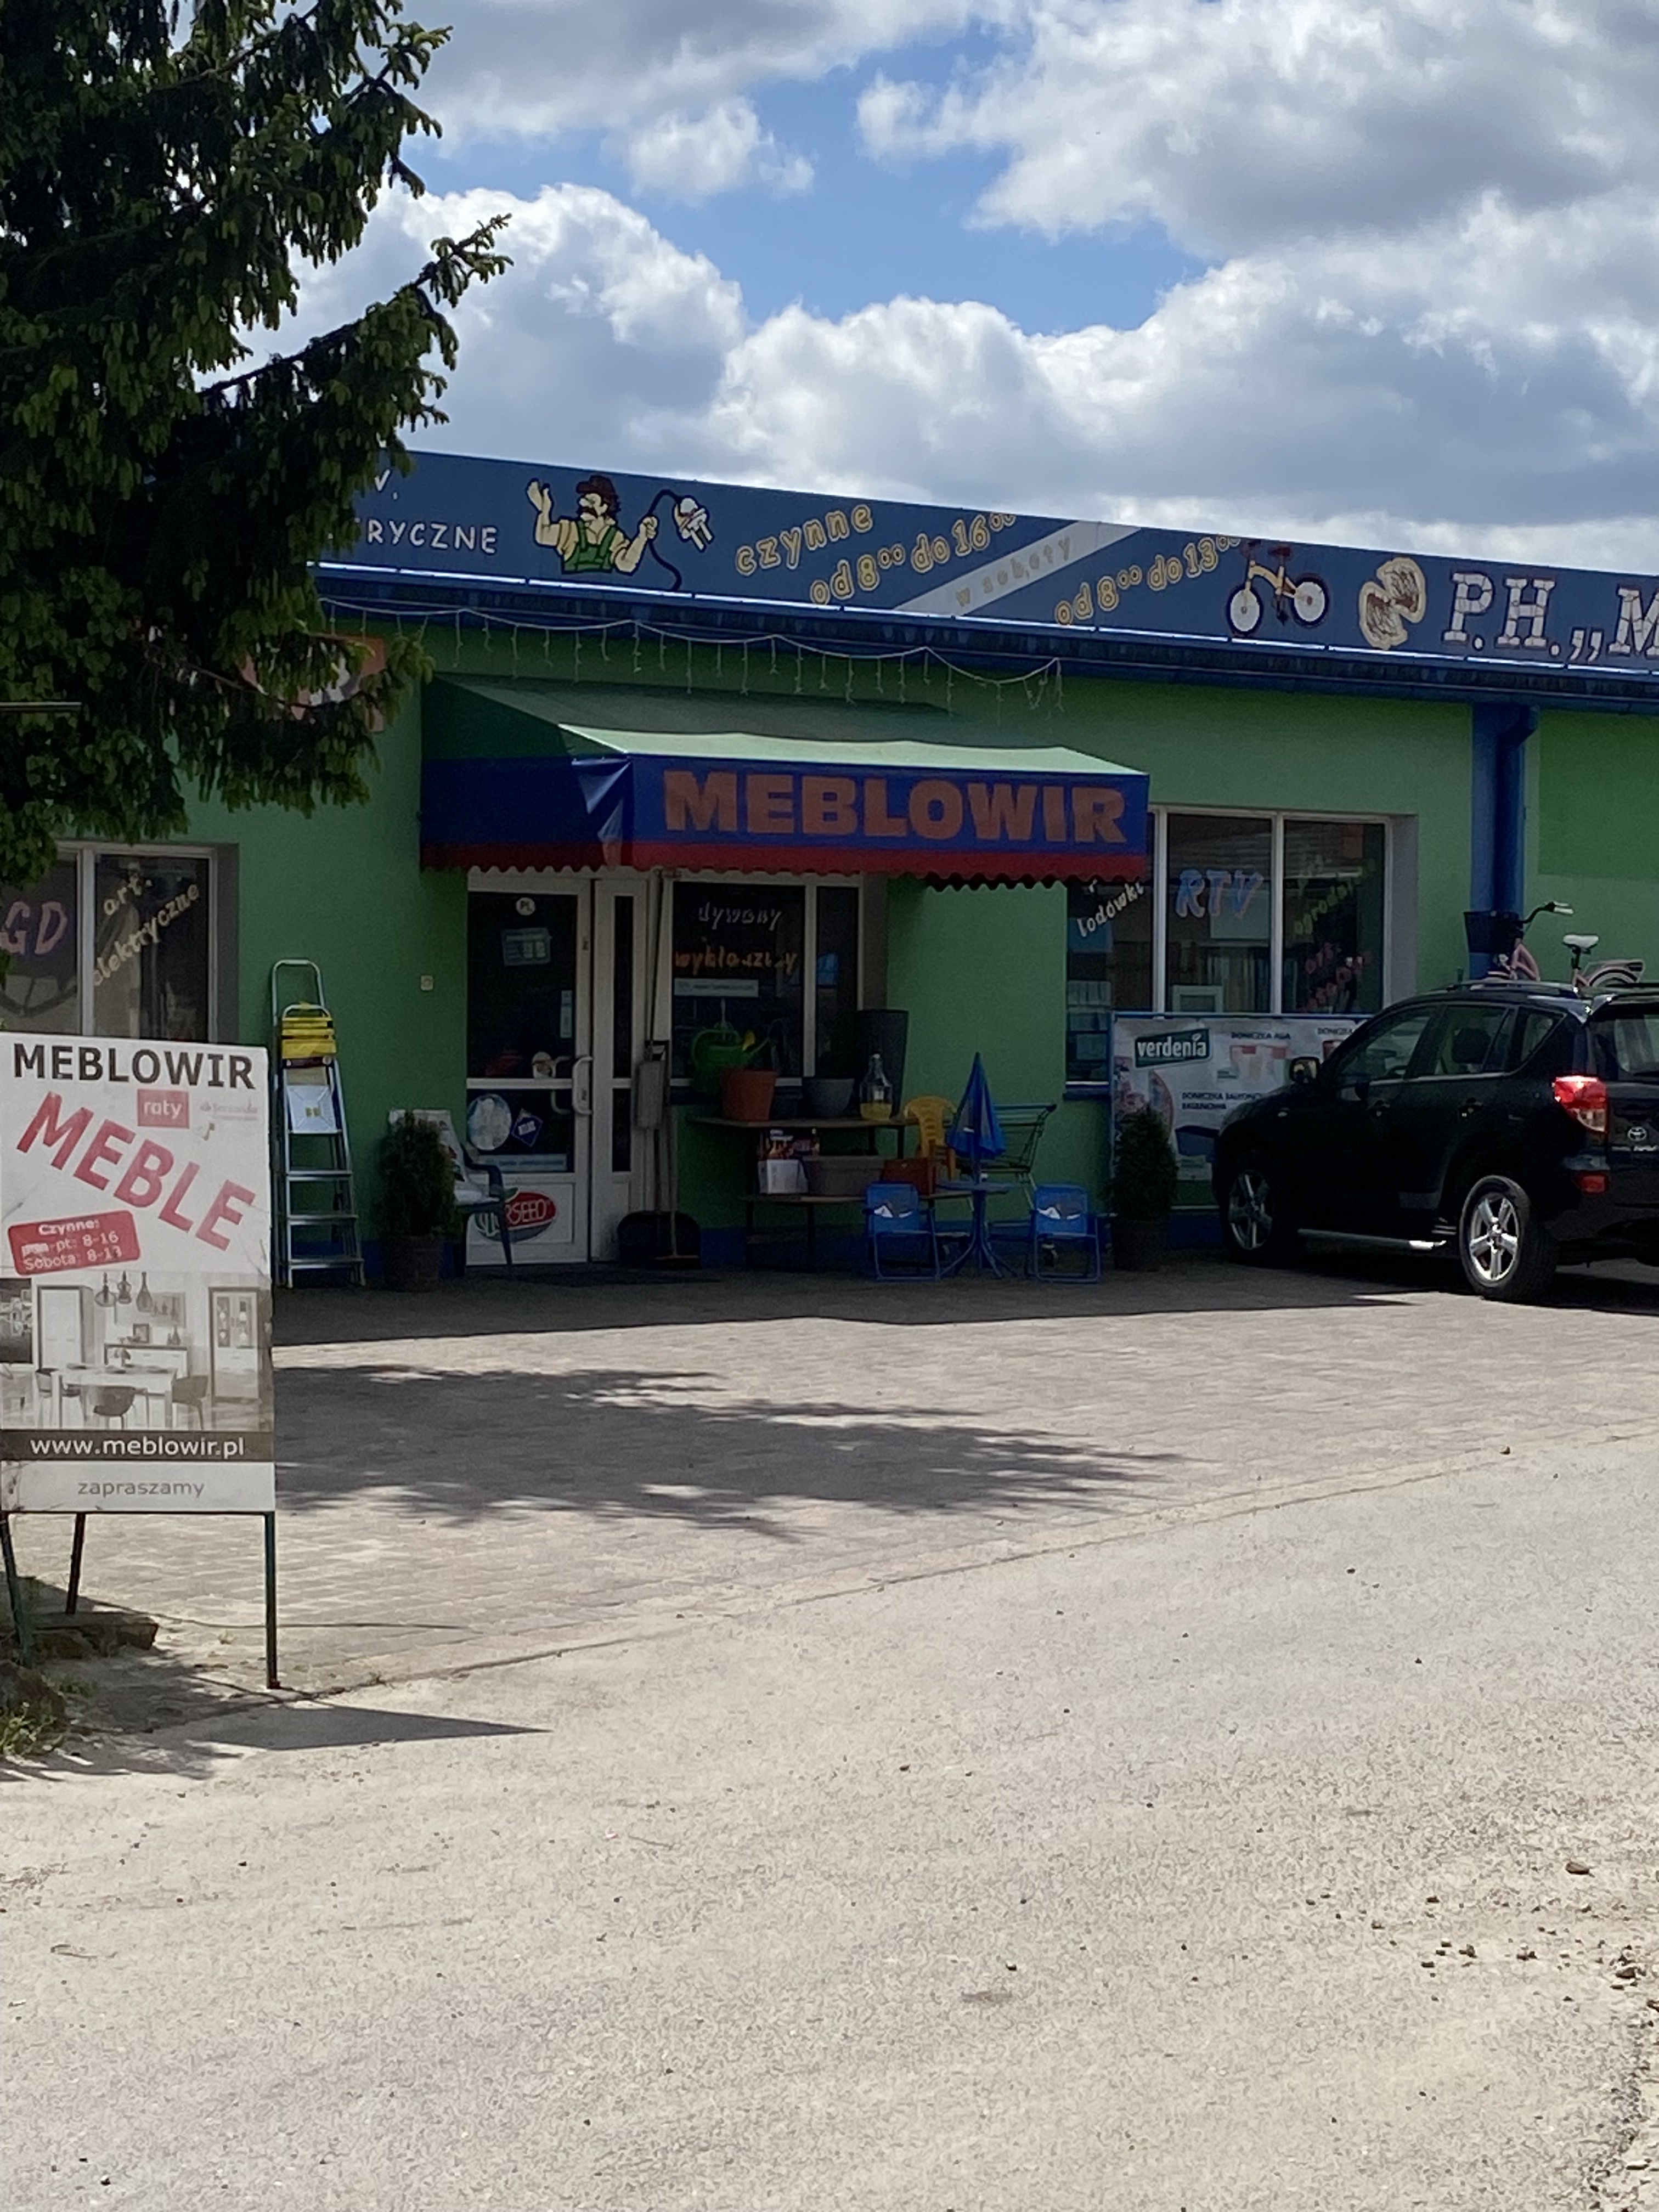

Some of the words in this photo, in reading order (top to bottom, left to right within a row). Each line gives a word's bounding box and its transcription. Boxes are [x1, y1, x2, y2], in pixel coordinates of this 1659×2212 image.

[354, 517, 498, 554] RYCZNE
[736, 504, 873, 575] czynne
[810, 558, 855, 605] od
[911, 532, 950, 573] do
[1054, 582, 1093, 625] od
[1147, 554, 1183, 591] do
[663, 770, 1128, 844] MEBLOWIR
[1175, 868, 1264, 919] RTV
[14, 1043, 255, 1090] MEBLOWIR
[144, 1099, 183, 1120] raty
[16, 1091, 256, 1251] MEBLE
[82, 1231, 119, 1247] 8-16
[30, 1436, 245, 1460] www.meblowir.pl
[77, 1481, 205, 1498] zapraszamy
